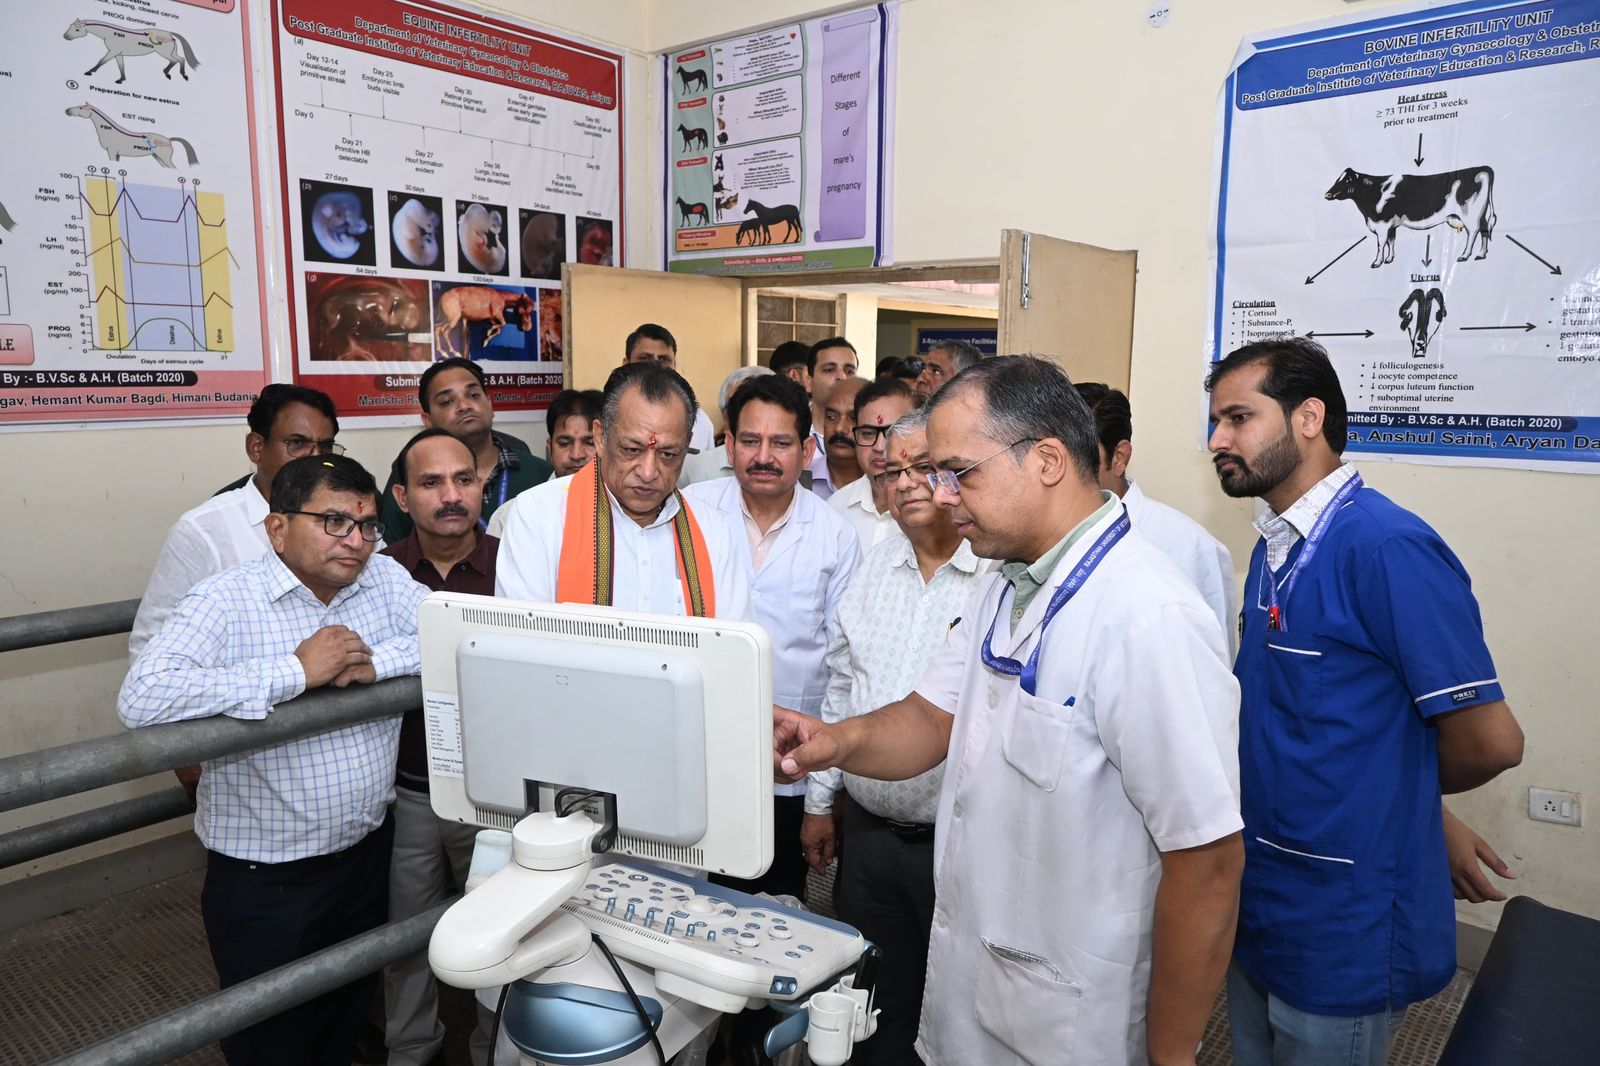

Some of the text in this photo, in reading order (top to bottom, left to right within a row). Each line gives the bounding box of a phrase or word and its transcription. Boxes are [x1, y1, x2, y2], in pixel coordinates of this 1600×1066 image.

[103, 10, 156, 27] PROG dominant
[138, 6, 159, 15] closed
[160, 10, 179, 19] cervix
[403, 12, 532, 57] EQUINE INFERTILITY UNIT
[1364, 9, 1553, 55] BOVINE INFERTILITY UNIT
[355, 16, 410, 40] Department
[413, 32, 423, 43] of
[423, 35, 467, 57] Veterinary
[470, 47, 521, 70] Gynaecology
[531, 63, 568, 80] Obstetrics
[289, 15, 315, 32] Post
[317, 23, 363, 44] Graduate
[365, 34, 404, 54] Institute
[406, 45, 416, 56] of
[417, 49, 461, 69] Veterinary
[463, 59, 504, 78] Education
[514, 73, 551, 91] Research,
[552, 81, 589, 100] RAJUVAS,
[591, 91, 613, 105] Jaipur
[306, 52, 338, 65] Day 12-14
[1307, 60, 1371, 80] Department
[1373, 56, 1386, 69] of
[1388, 47, 1447, 65] Veterinary
[1450, 33, 1533, 56] Gynaecology
[1537, 29, 1546, 42] &
[300, 60, 337, 75] Visualisation
[372, 67, 385, 77] Day
[1241, 92, 1266, 105] Post
[1267, 84, 1315, 101] Graduate
[1316, 76, 1361, 93] Institute
[1363, 73, 1376, 85] of
[1378, 65, 1436, 83] Veterinary
[1440, 53, 1502, 73] Education
[1505, 51, 1516, 63] &
[1519, 41, 1586, 61] Research,
[300, 70, 346, 84] primitive streak
[362, 74, 404, 88] Embryonic limb
[830, 70, 861, 84] Different
[90, 85, 130, 98] Preparation
[159, 98, 180, 106] estrus
[382, 86, 400, 96] visible
[1397, 90, 1448, 105] Heat stress
[834, 99, 858, 112] Stages
[1385, 97, 1468, 116] 73 THI for 3 weeks
[122, 112, 155, 124] EST rising
[295, 109, 308, 118] Day
[1384, 119, 1404, 129] prior
[1417, 110, 1458, 123] treatment
[842, 127, 850, 137] of
[342, 137, 354, 146] Day
[334, 144, 360, 155] Primitive
[415, 150, 426, 159] Day
[338, 154, 368, 165] detectable
[405, 156, 443, 168] Hoof formation
[833, 154, 855, 165] mare's
[415, 166, 434, 175] evident
[333, 174, 348, 183] days
[39, 187, 55, 195] FSH
[412, 185, 425, 193] days
[827, 180, 861, 194] pregnancy
[35, 193, 60, 203] (ng/ml)
[40, 242, 64, 251] (ng/ml)
[1410, 272, 1441, 282] Uterus
[1232, 300, 1276, 309] Circulation
[1247, 309, 1277, 317] Cortisol
[48, 331, 72, 340] (ng/ml)
[1557, 355, 1595, 364] embryo
[1379, 361, 1444, 371] folliculogenesis
[3, 373, 20, 386] By
[36, 372, 76, 384] B.V.Sc
[78, 372, 88, 383] &
[90, 372, 115, 383] A.H.
[117, 371, 153, 385] (Batch
[156, 372, 185, 385] 2020)
[489, 377, 496, 386] &
[497, 376, 515, 386] A.H.
[517, 375, 543, 387] (Batch
[1378, 373, 1458, 383] oocyte competence
[1378, 383, 1474, 392] corpus luteum function
[31, 395, 82, 405] Hemant
[86, 394, 128, 405] Kumar
[131, 393, 169, 406] Bagdi,
[172, 392, 211, 403] Himani
[358, 394, 404, 407] Manisha
[1377, 394, 1422, 403] suboptimal
[1380, 415, 1395, 426] By
[1408, 415, 1444, 425] B.V.Sc
[1446, 416, 1455, 425] &
[1458, 416, 1482, 426] A.H.
[1486, 416, 1525, 428] (Batch
[1528, 418, 1562, 430] 2020)
[1367, 429, 1435, 444] Anshul
[1440, 431, 1497, 448] Saini,
[1501, 433, 1566, 451] Aryan
[1083, 529, 1119, 568] RAJASTHAN UNIVERSITY
